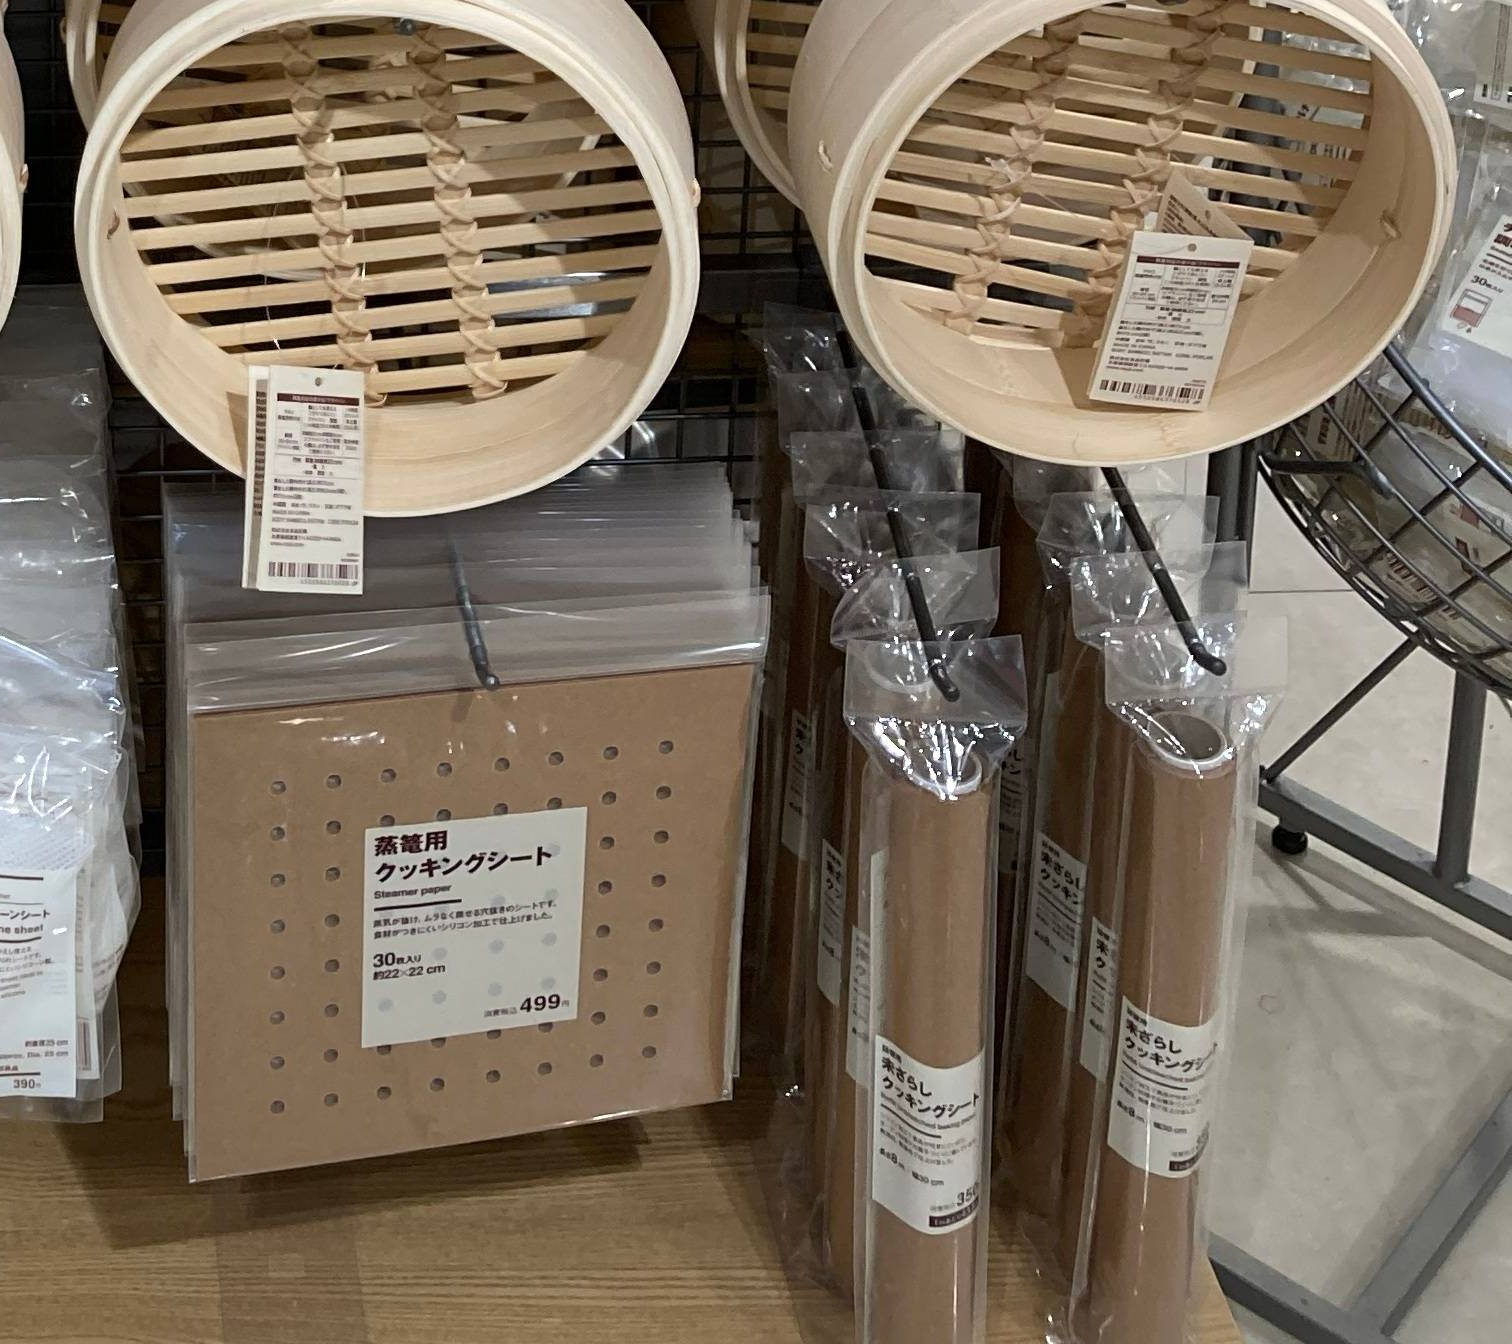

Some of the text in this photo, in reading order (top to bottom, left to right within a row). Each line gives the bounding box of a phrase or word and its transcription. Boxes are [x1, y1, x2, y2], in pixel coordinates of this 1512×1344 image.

[375, 846, 553, 883] クッキングシート
[374, 884, 452, 900] Steamer paper
[14, 924, 44, 935] sheet
[373, 952, 422, 968] 30枚入り
[426, 963, 446, 975] cm
